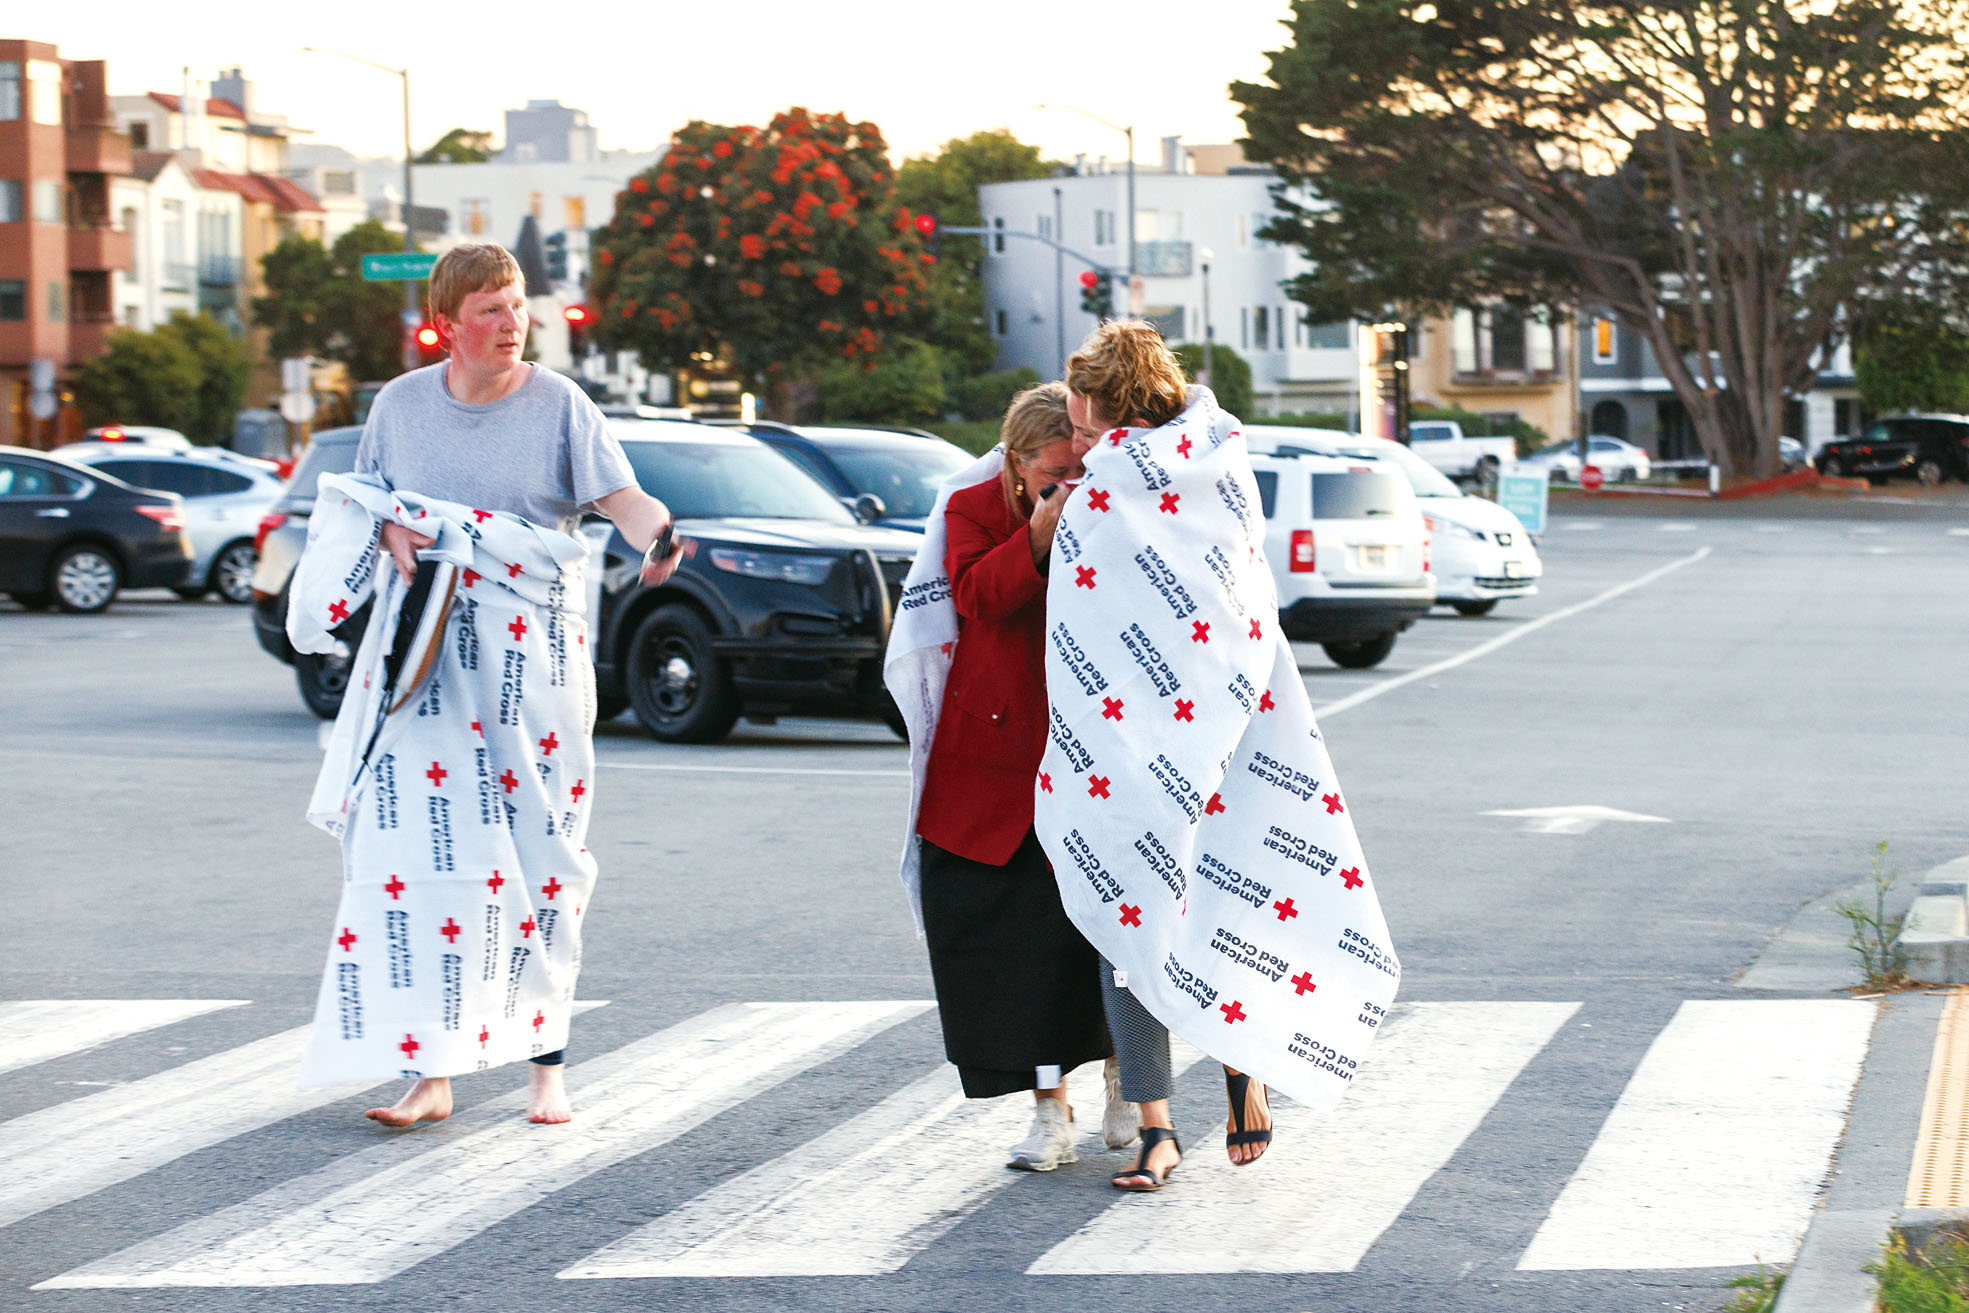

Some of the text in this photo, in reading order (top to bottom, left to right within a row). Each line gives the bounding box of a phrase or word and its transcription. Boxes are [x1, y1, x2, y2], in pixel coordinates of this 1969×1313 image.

[1123, 443, 1160, 490] Americ
[1150, 461, 1172, 487] Red
[344, 521, 382, 588] American
[1144, 545, 1198, 614] Red Cross
[902, 594, 928, 610] Red
[1134, 553, 1188, 620] American
[467, 597, 480, 670] American
[1058, 622, 1109, 692] Red Cross
[1129, 622, 1181, 692] Red Cross
[499, 649, 515, 725] Red Cross
[512, 651, 527, 726] American
[1051, 630, 1098, 697] American
[1120, 631, 1171, 698] American
[1235, 673, 1256, 698] oss
[1228, 683, 1251, 714] ican
[1050, 700, 1095, 769] Red Cros
[1050, 722, 1085, 774] Americ
[384, 753, 398, 829] American
[474, 748, 490, 824] Red Cross
[1156, 754, 1191, 792] Cross
[1248, 762, 1313, 802] American
[1254, 751, 1293, 778] Cross
[1292, 771, 1319, 792] Red
[375, 785, 386, 830] Cross
[1148, 762, 1198, 825] American
[428, 796, 442, 872] Red Cross
[438, 796, 455, 871] American
[1144, 831, 1177, 869] Cross
[1263, 837, 1332, 877] American
[1268, 825, 1338, 867] Red Cross
[1062, 836, 1115, 904] American
[1070, 828, 1125, 898] Red Cross
[1134, 839, 1183, 901] American
[1195, 864, 1266, 909] American
[1201, 853, 1272, 900] Red Cross
[385, 910, 401, 989] Red Cross
[397, 910, 414, 988] American
[1210, 938, 1283, 983] American
[1216, 927, 1289, 973] Red Cross
[1338, 939, 1399, 980] merican
[1343, 927, 1383, 959] Cross
[349, 962, 362, 1039] American
[441, 953, 453, 1031] Red Cross
[448, 953, 463, 1030] American
[1164, 962, 1212, 1010] American
[1168, 951, 1219, 1001] Red Cross
[1287, 1043, 1353, 1083] merican
[1293, 1032, 1357, 1070] ed Cross
